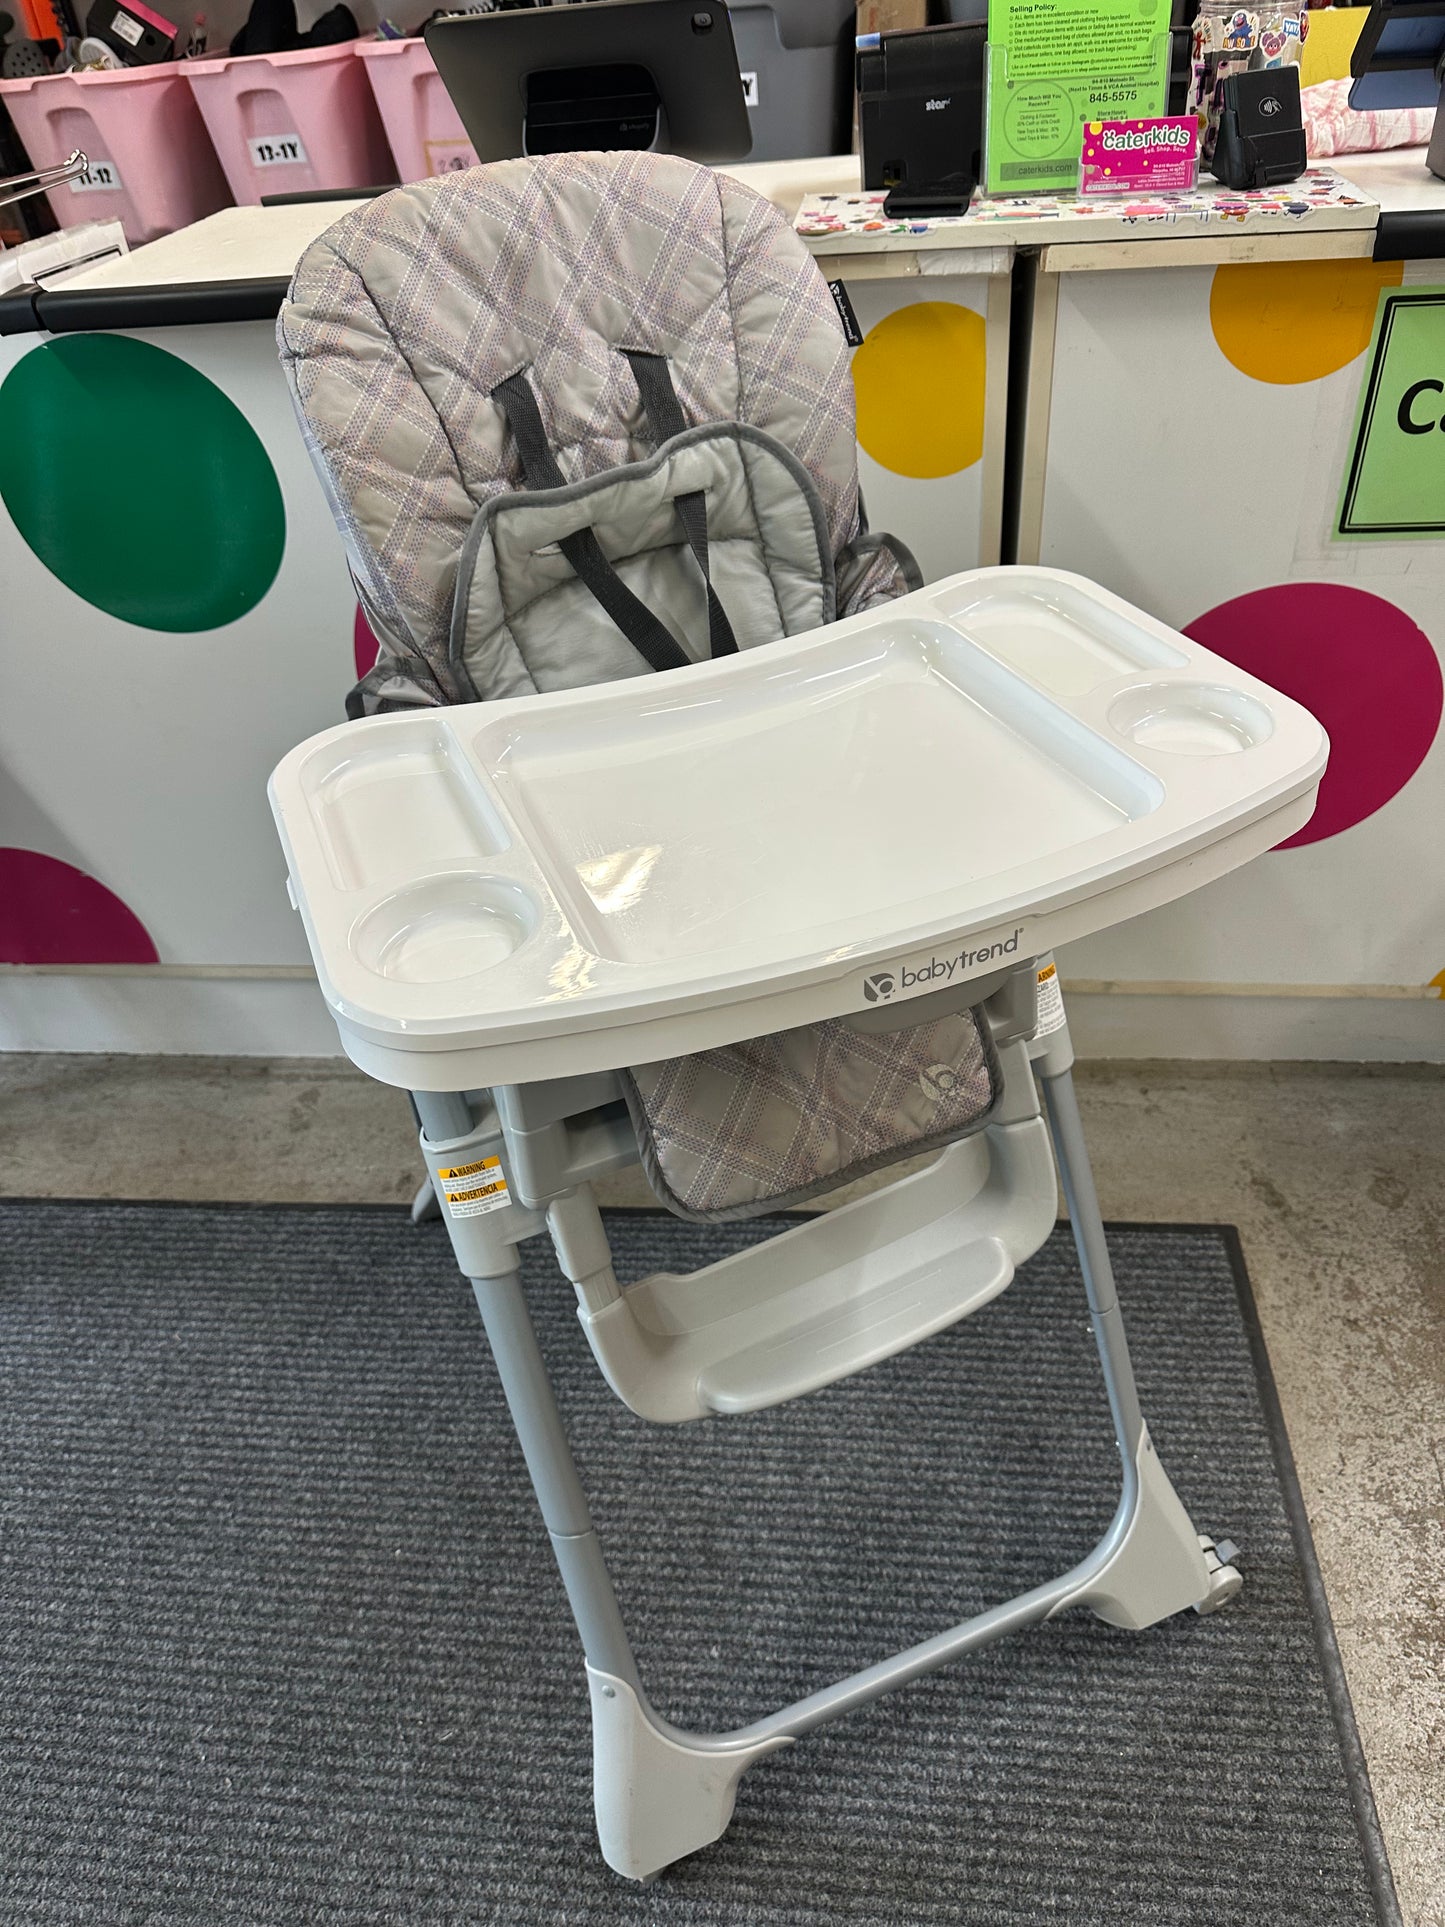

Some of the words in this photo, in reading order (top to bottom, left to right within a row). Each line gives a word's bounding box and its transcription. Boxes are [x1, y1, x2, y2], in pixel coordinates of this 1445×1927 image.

[1009, 5, 1033, 13] Selling
[1034, 3, 1057, 11] Policy:
[1089, 90, 1137, 103] 845-5575
[925, 99, 946, 111] star
[1018, 164, 1072, 175] caterkids.com
[901, 927, 1019, 988] babytrend
[457, 1161, 486, 1177] WARNING
[458, 1182, 498, 1201] ADVERTENCIA
